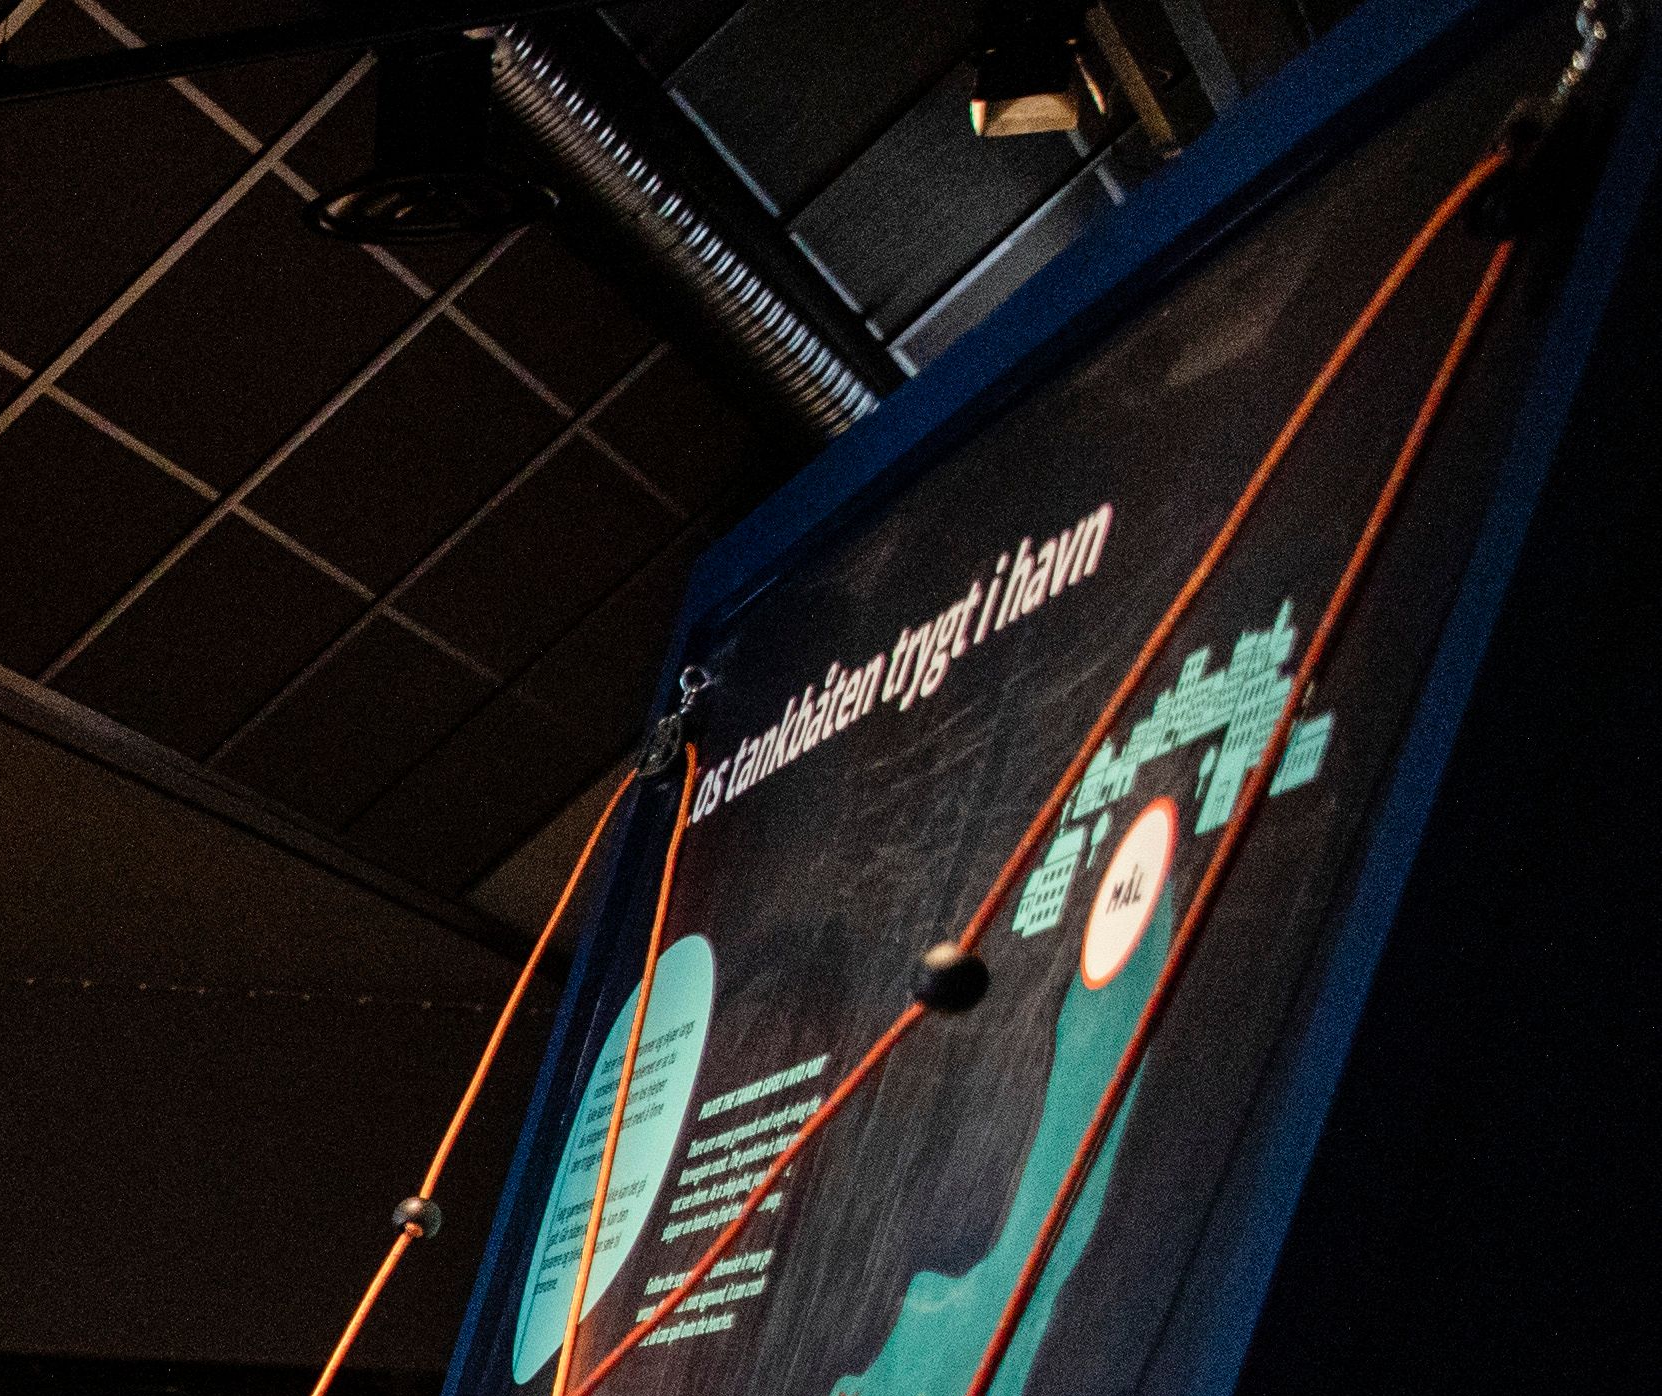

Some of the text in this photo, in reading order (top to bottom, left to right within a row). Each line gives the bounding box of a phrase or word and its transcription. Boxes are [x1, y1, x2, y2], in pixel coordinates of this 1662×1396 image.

[686, 501, 1113, 828] os tankbåten trygt i havn
